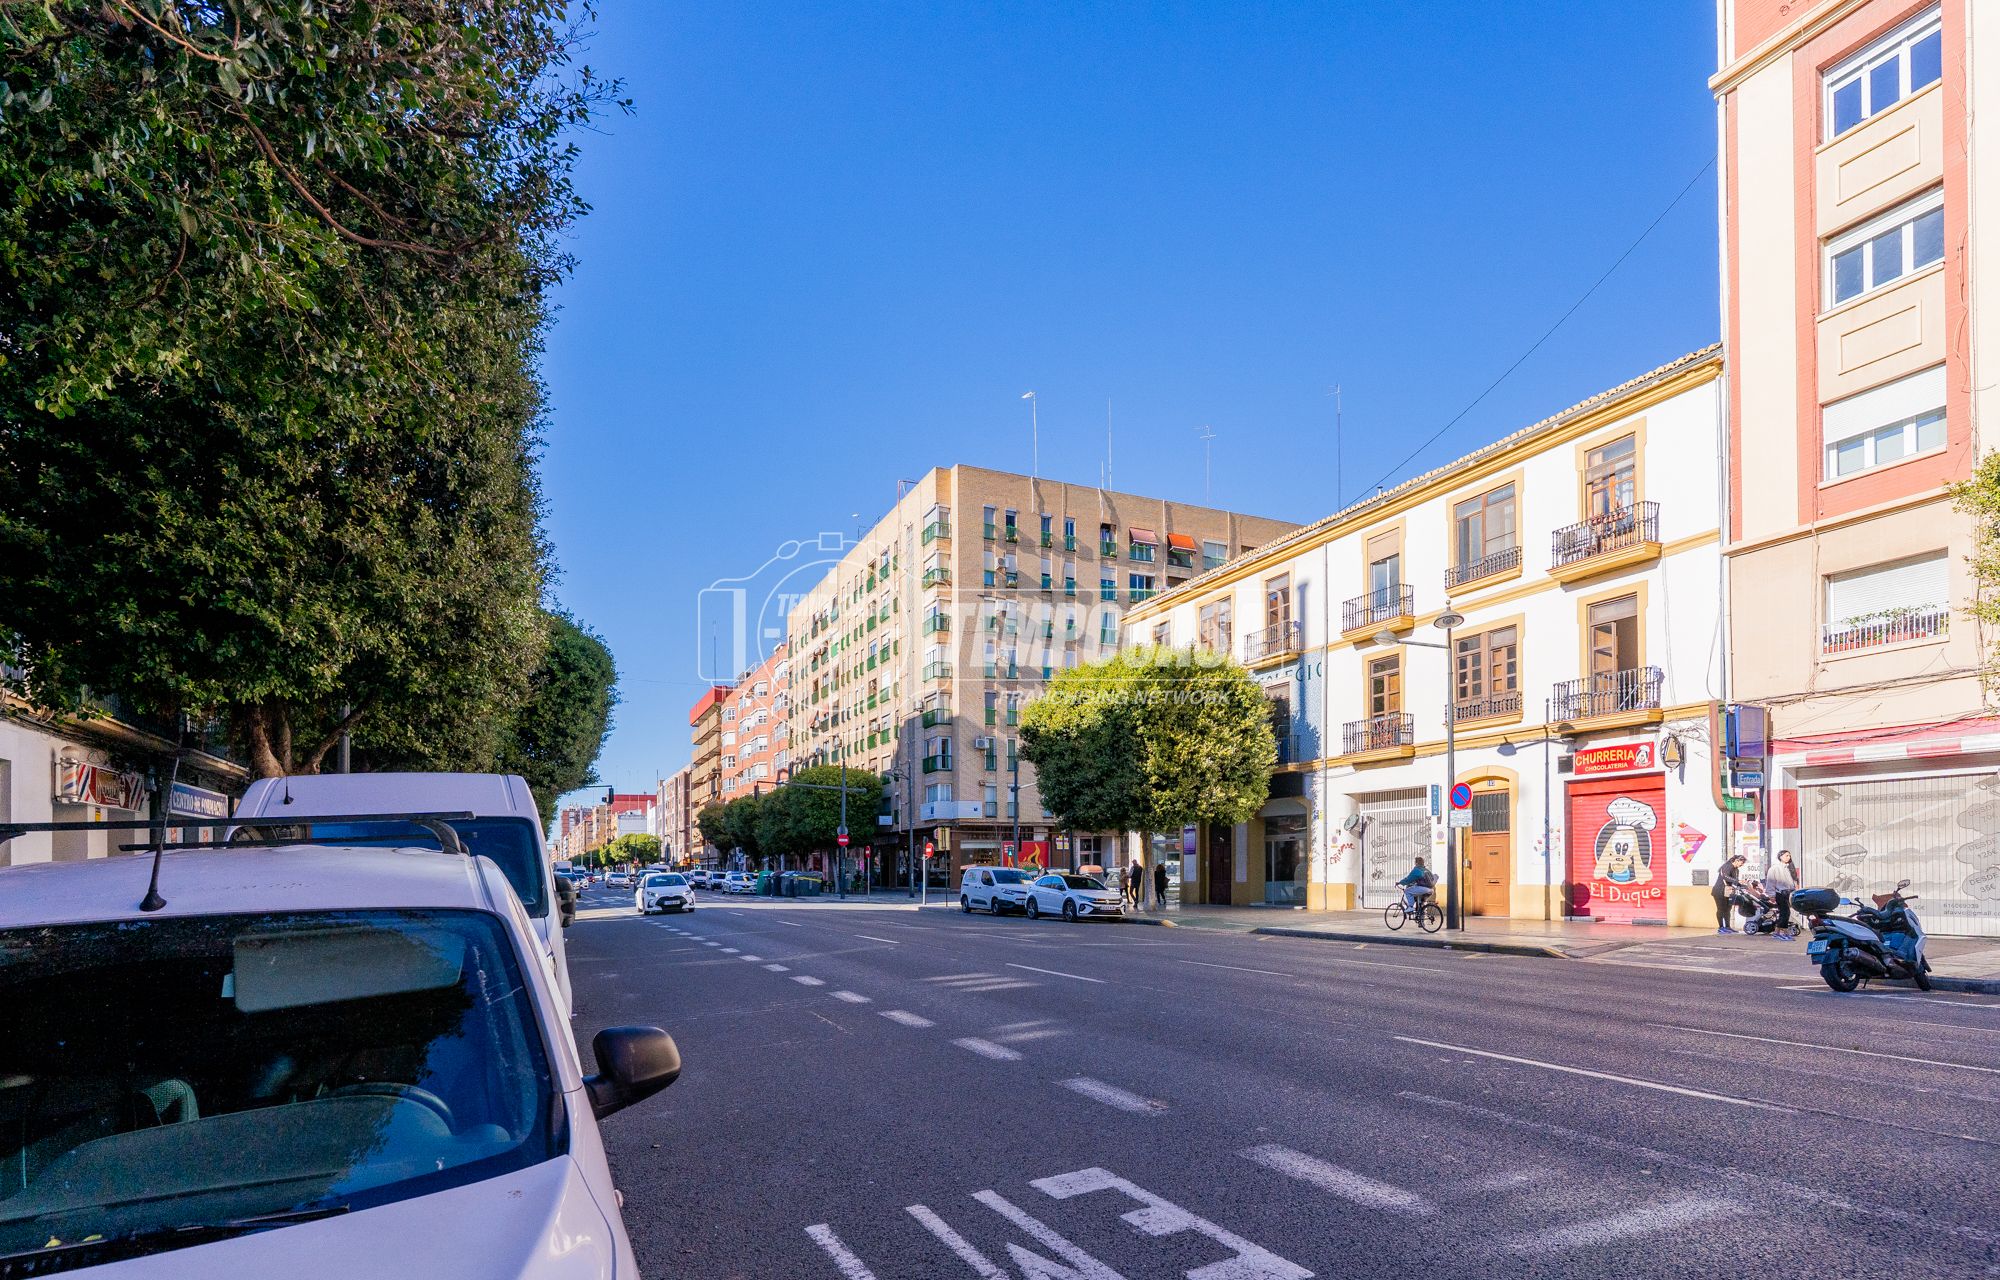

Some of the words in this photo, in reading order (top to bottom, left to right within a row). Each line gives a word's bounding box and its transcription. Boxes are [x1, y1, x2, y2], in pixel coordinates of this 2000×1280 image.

[1575, 749, 1635, 767] CHURRERIA
[1584, 762, 1629, 772] CHOCOLATERIA
[1740, 774, 1761, 784] Entrada
[1967, 838, 1998, 851] DESDE
[1969, 872, 1999, 886] DESDE
[1979, 882, 1997, 893] 35€
[1590, 881, 1605, 898] El
[1608, 885, 1662, 908] Duque
